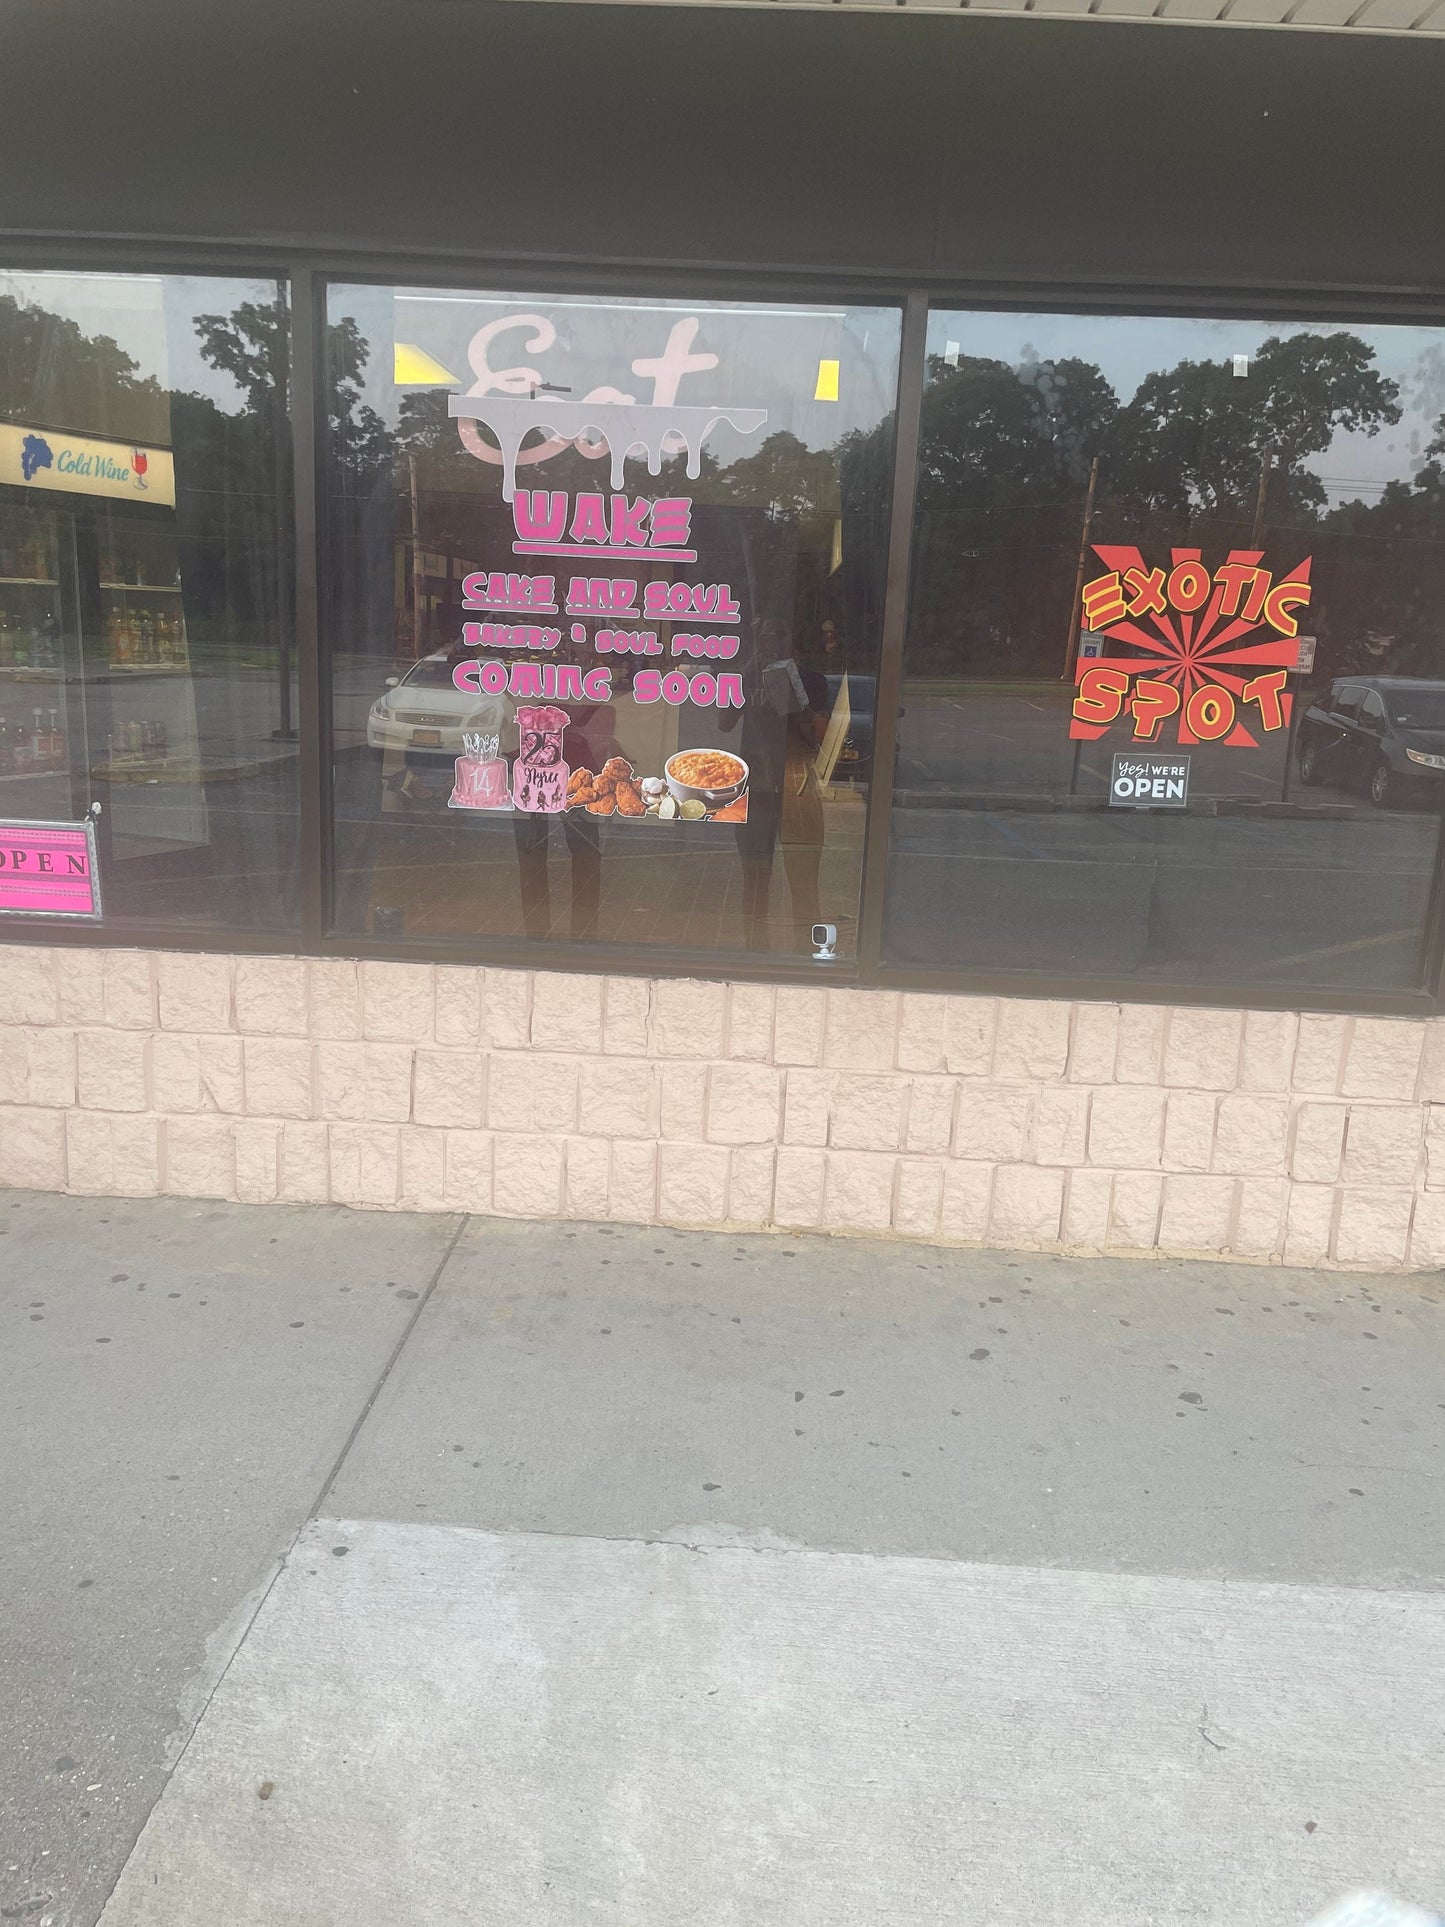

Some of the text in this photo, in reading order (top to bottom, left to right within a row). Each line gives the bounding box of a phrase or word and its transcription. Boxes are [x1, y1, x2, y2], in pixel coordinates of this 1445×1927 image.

[57, 450, 129, 481] Cold Wine
[513, 489, 692, 547] WAKE
[462, 572, 740, 616] CAKE AND SOUL
[1082, 560, 1312, 637] EXOTIC
[462, 622, 561, 649] BAKERY
[595, 630, 663, 655] SOUL
[671, 634, 740, 659] FOOD
[453, 660, 745, 708] COMING SOON
[1073, 668, 1288, 740] SPOT
[523, 732, 561, 767] 25
[470, 768, 493, 797] 14
[1114, 777, 1184, 798] OPEN
[1118, 761, 1185, 778] Yes! WE'RE
